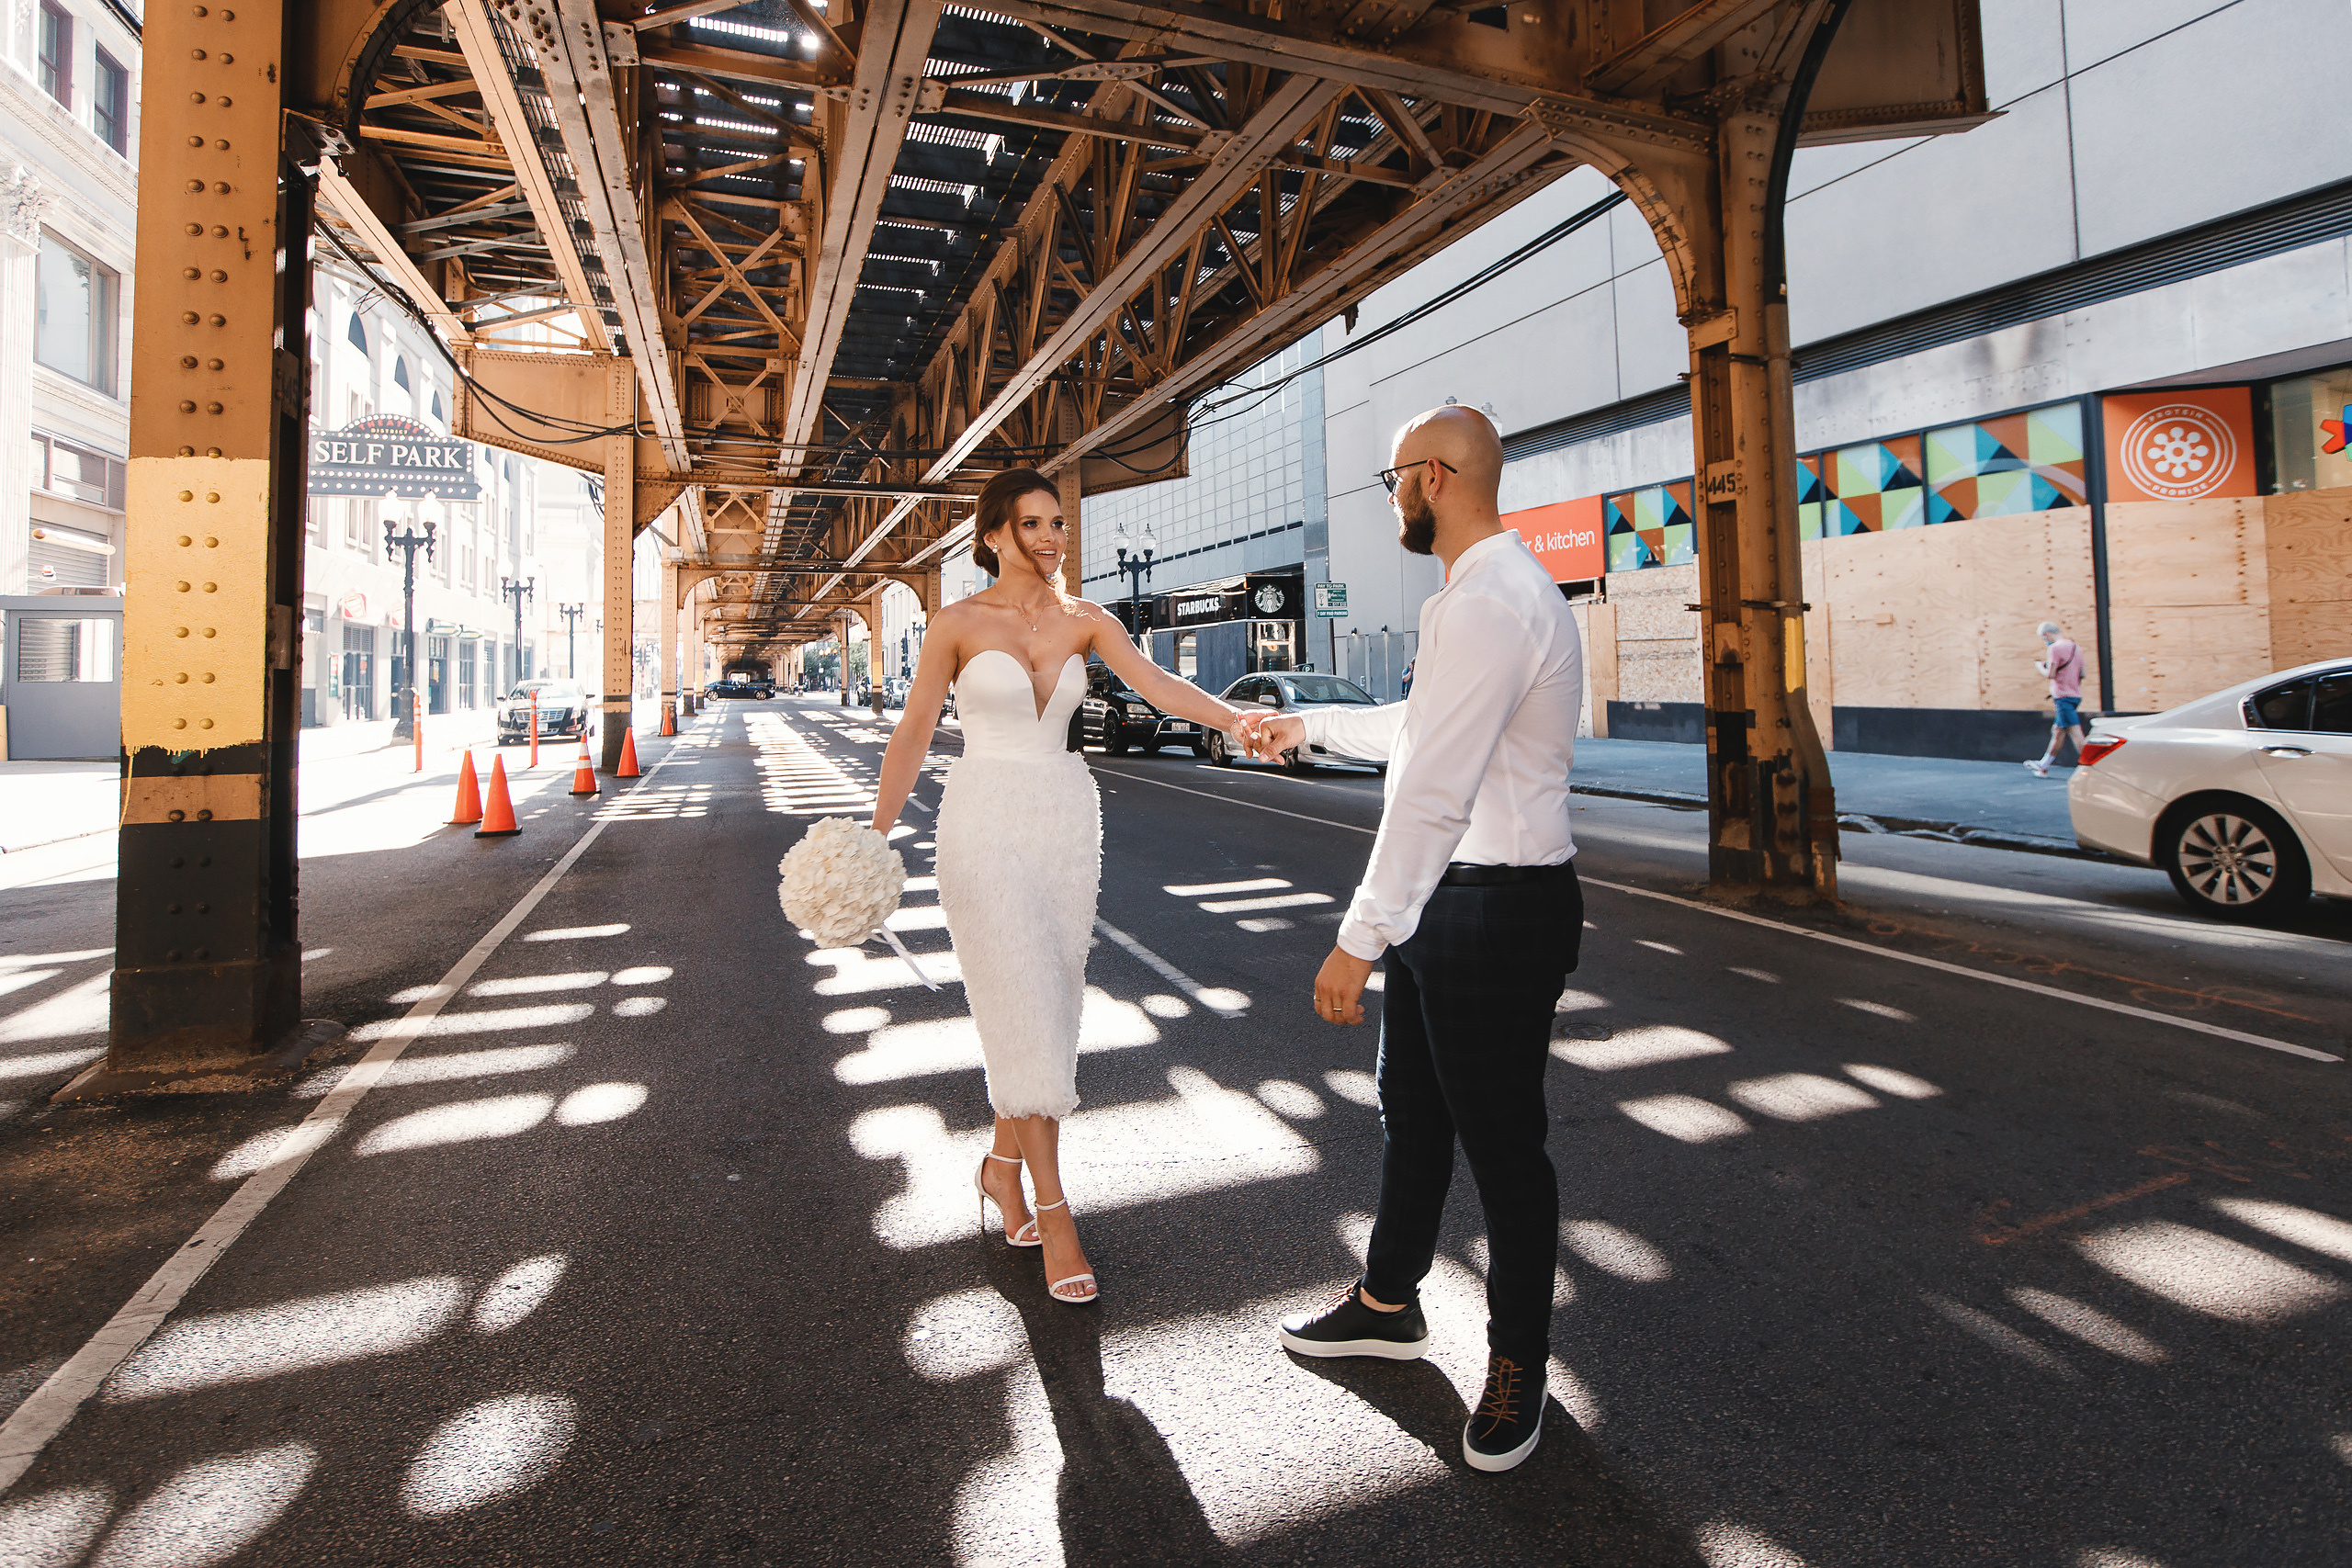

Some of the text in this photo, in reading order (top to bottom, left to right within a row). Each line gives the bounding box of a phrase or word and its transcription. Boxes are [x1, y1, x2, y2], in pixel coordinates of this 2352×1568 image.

[2148, 409, 2203, 422] PROTEIN
[358, 419, 419, 434] THEATRE
[370, 427, 408, 435] DISTRICT
[314, 440, 463, 469] SELF PARK
[1708, 471, 1736, 495] 445
[2151, 482, 2208, 496] PROMISE
[1534, 535, 1544, 553] &
[1546, 528, 1595, 551] kitchen
[1177, 597, 1220, 616] STARBUCKS
